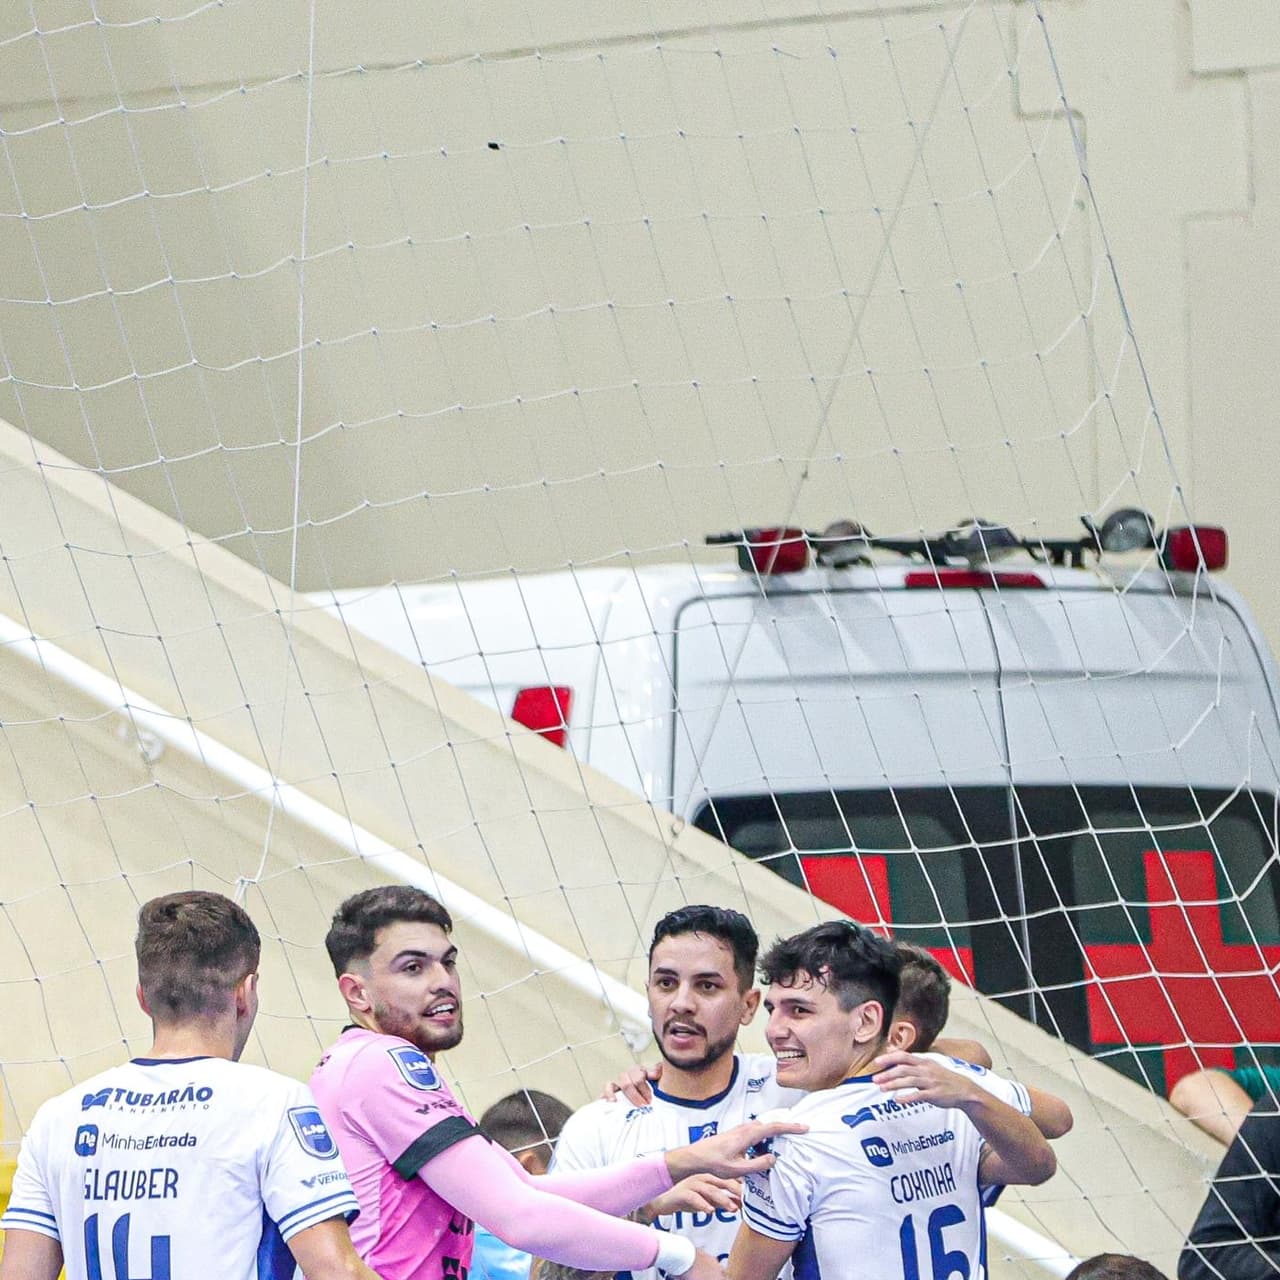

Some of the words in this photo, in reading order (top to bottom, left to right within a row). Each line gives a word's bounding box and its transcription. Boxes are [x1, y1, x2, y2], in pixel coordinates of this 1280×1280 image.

[114, 1082, 213, 1106] TUBARÃO
[101, 1132, 197, 1151] MinhaEntrada
[891, 1129, 955, 1156] MinhaEntrada
[84, 1168, 179, 1200] GLAUBER
[890, 1162, 957, 1204] COXINHA
